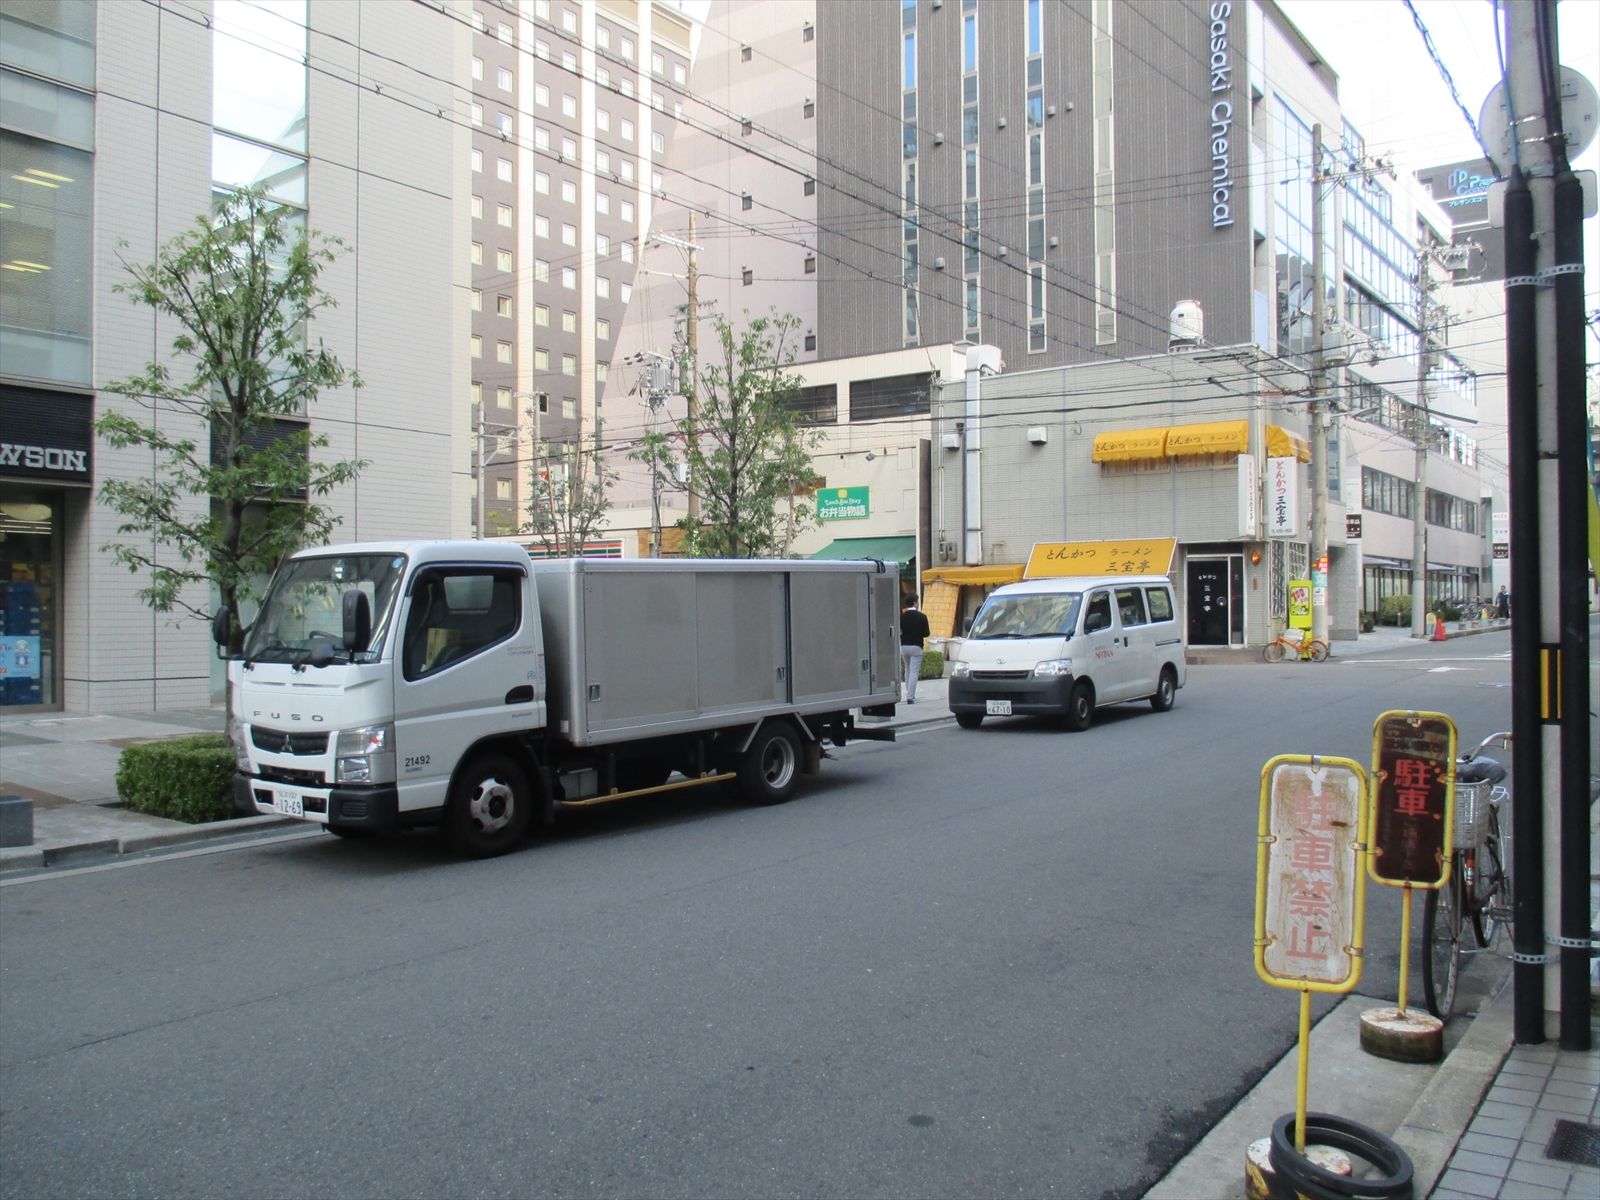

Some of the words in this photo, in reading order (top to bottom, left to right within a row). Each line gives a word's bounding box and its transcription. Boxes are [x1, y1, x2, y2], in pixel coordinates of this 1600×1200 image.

[1210, 2, 1232, 92] Sasaki
[1210, 101, 1235, 228] Chemical
[820, 505, 865, 518] お弁当物語
[1046, 546, 1097, 560] とんかつ
[1110, 547, 1153, 556] ラーメン
[1105, 560, 1150, 573] 三宝亭
[253, 710, 324, 722] FUSO
[404, 754, 431, 767] 21492
[1286, 789, 1336, 961] 駐車禁止
